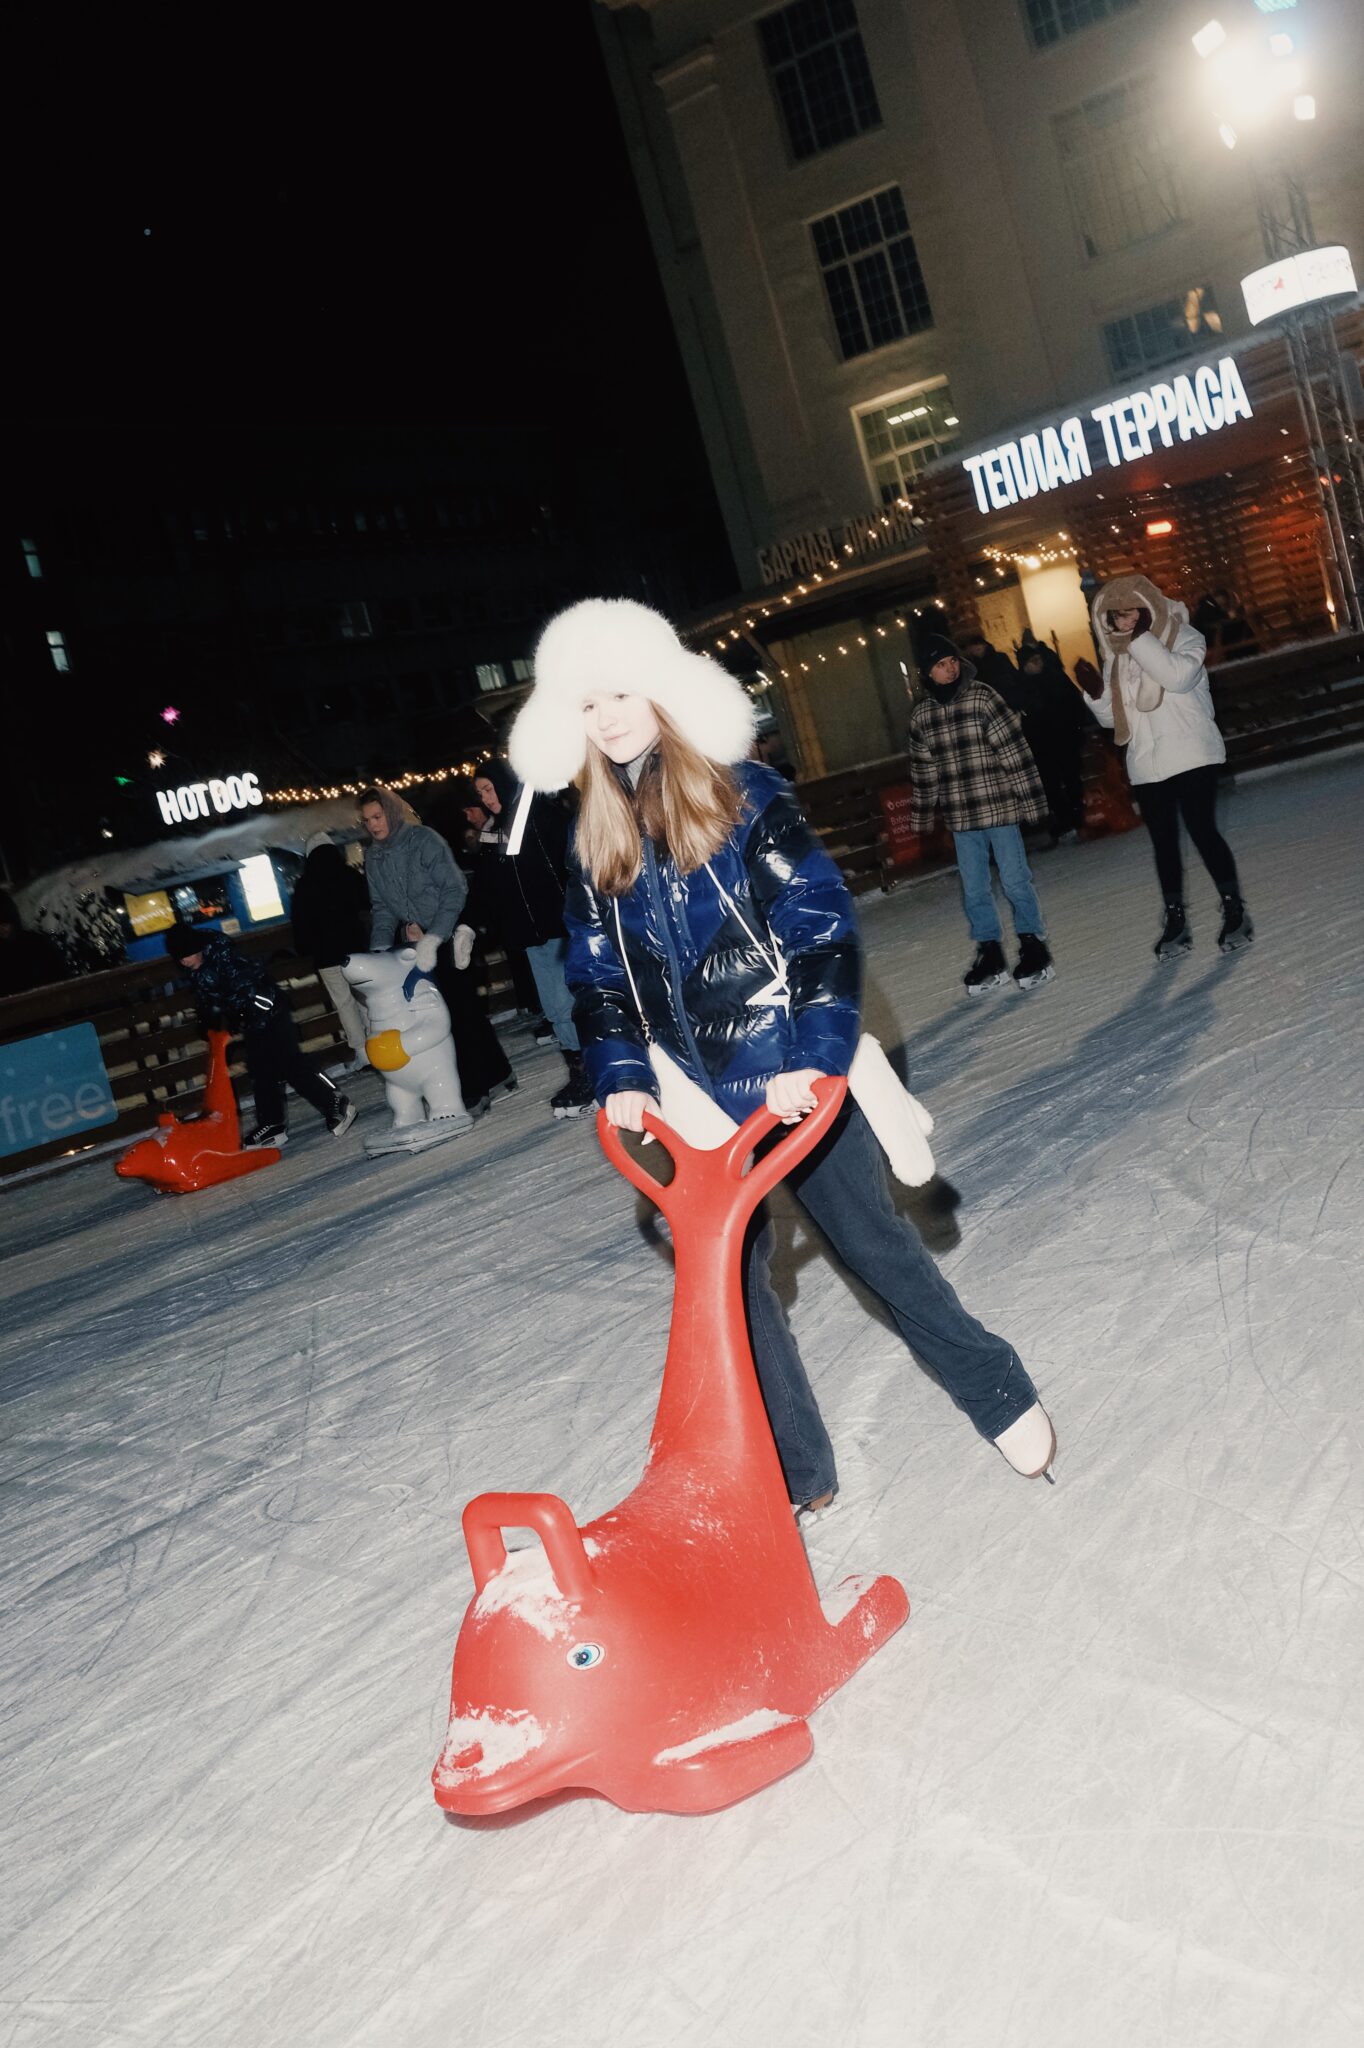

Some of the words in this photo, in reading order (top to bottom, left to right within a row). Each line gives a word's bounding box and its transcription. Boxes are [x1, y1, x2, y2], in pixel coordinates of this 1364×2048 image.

[962, 416, 1093, 515] ТЕПЛАЯ
[1091, 356, 1254, 468] ТЕРРАСА
[758, 527, 837, 585] БАРНАЯ
[156, 782, 210, 826] HOT
[208, 772, 263, 814] DOG
[0, 1082, 107, 1145] free
